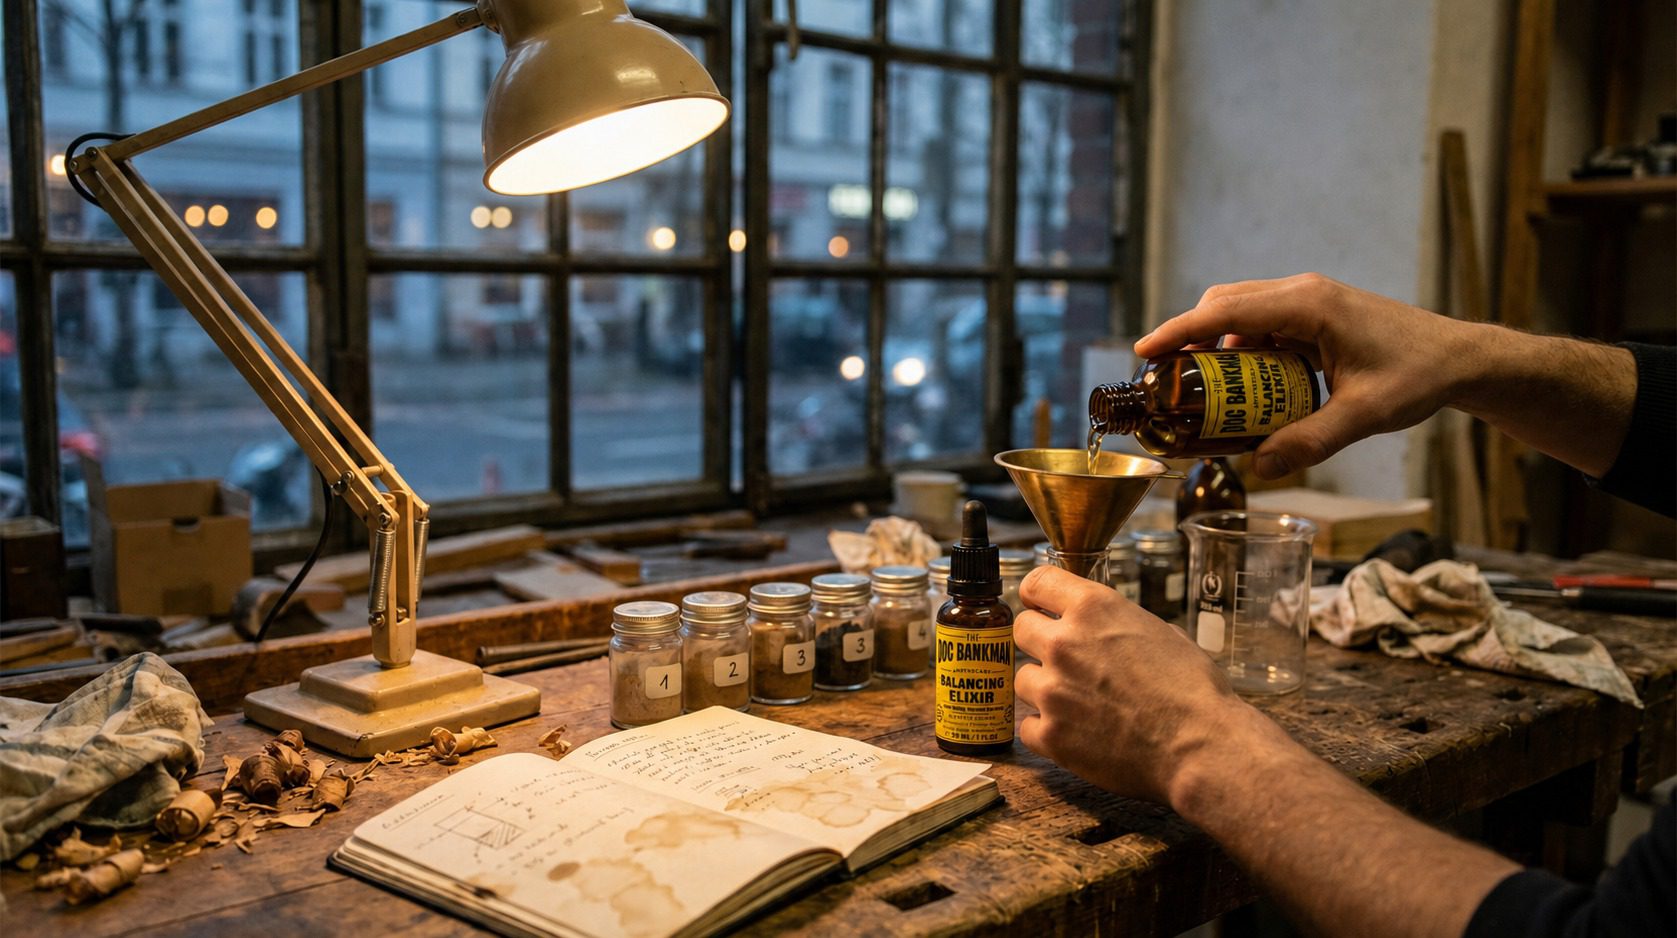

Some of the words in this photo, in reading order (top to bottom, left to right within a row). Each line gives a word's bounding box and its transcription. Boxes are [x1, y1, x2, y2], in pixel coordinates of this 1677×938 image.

[1254, 356, 1274, 425] BALANCING
[1269, 364, 1286, 413] ELIXIR
[1221, 409, 1247, 433] DOC
[855, 637, 866, 654] 3
[966, 633, 980, 642] THE
[796, 649, 807, 666] 3
[957, 640, 1011, 666] BANKMAN
[728, 661, 740, 678] 2
[659, 674, 669, 690] 1
[941, 674, 1005, 690] BALANCING
[949, 690, 995, 704] ELIXIR
